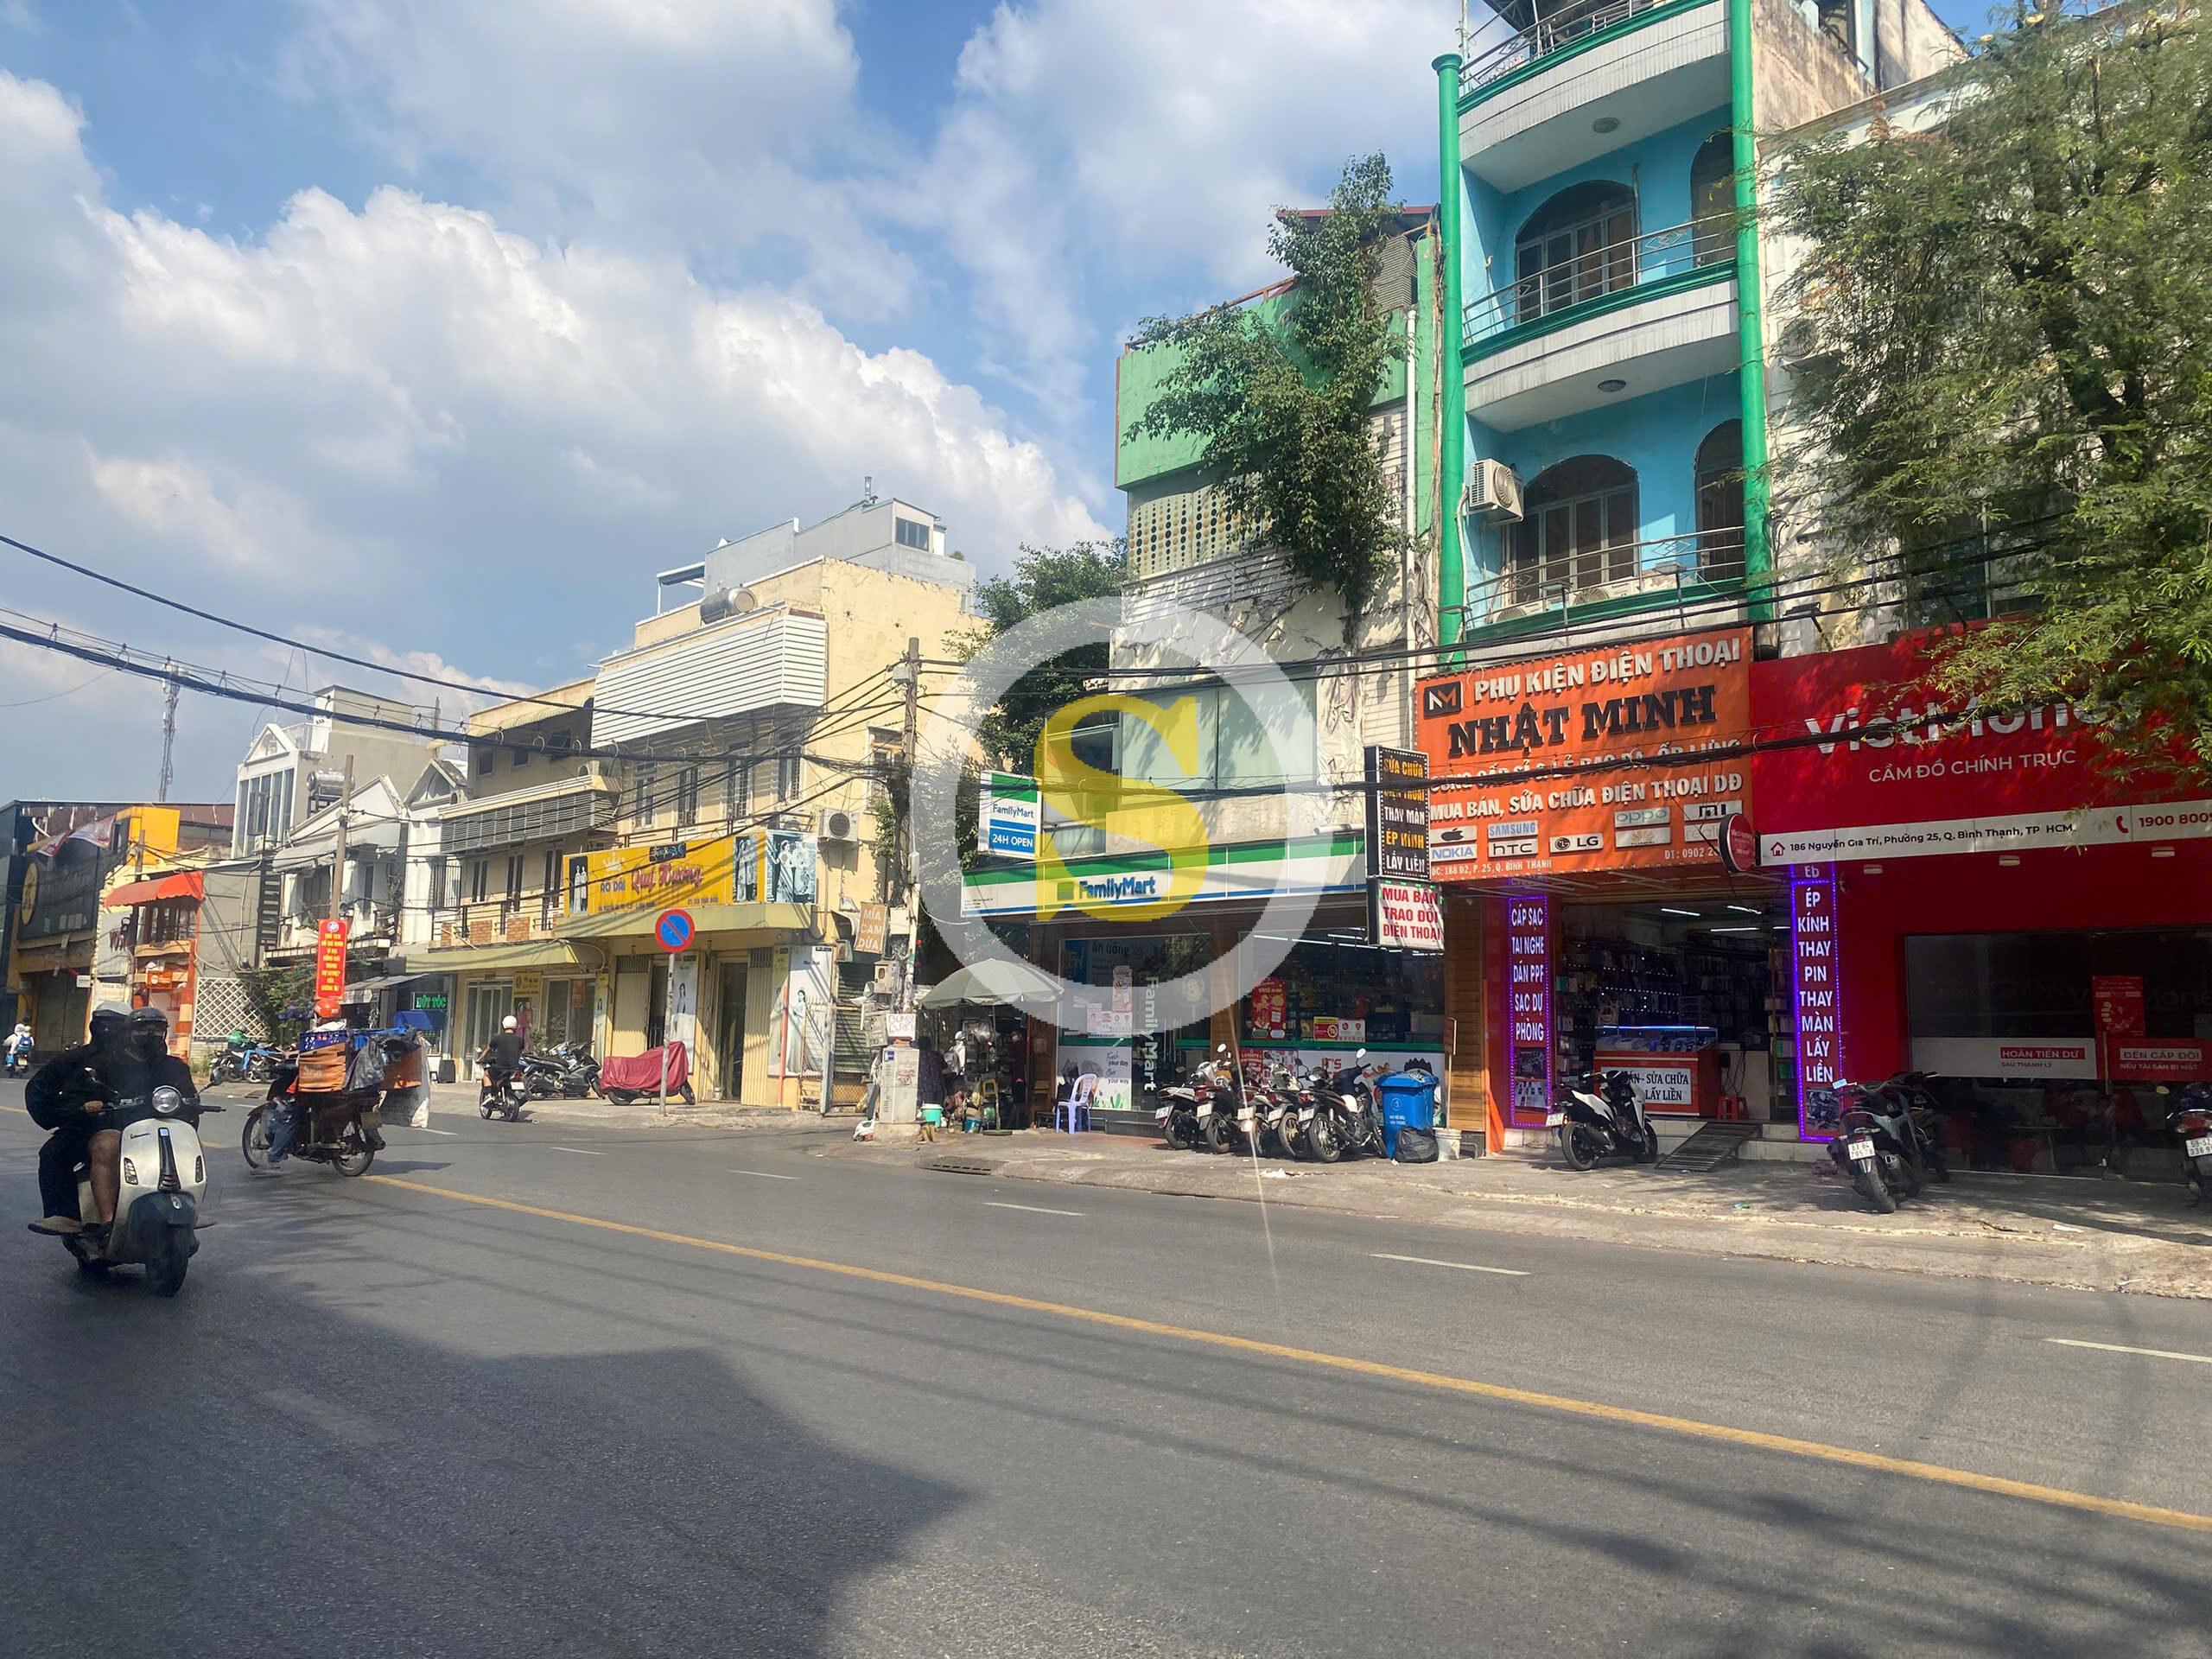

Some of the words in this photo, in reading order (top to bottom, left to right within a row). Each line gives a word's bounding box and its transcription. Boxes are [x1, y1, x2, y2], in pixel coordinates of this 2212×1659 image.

[1475, 674, 1521, 701] PHỤ
[1526, 663, 1584, 694] KIỆN
[1590, 651, 1652, 683] ĐIỆN
[1659, 638, 1740, 671] THOẠI
[1448, 702, 1571, 758] NHẬT
[1581, 685, 1717, 741] MINH
[1869, 763, 1911, 782] CẦM
[1916, 758, 1945, 778] ĐỒ
[1951, 754, 2012, 774] CHÍNH
[2019, 750, 2076, 769] TRỰC
[1430, 802, 1464, 820] MUA
[1467, 796, 1504, 817] BÁN,
[1510, 789, 1543, 813] SỬA
[1548, 785, 1596, 809] CHỮA
[1601, 780, 1645, 804] ĐIỆN
[1651, 776, 1709, 798] THOẠI
[992, 804, 1034, 818] FamilyMart
[1384, 806, 1404, 822] THAY
[1407, 807, 1425, 824] MÀN
[2139, 815, 2174, 828] 1900
[2179, 812, 2212, 824] 800
[1386, 829, 1398, 844] ÉP
[1489, 823, 1535, 836] SAMSUNG
[1790, 842, 1806, 852] 186
[1808, 838, 1846, 852] Nguyễn
[1848, 839, 1864, 848] Gia
[1866, 836, 1882, 846] Trí,
[1885, 833, 1924, 844] Phường
[1927, 832, 1942, 842] 25,
[1944, 831, 1956, 841] Q.
[1958, 829, 1982, 840] Bình
[1985, 827, 2024, 838] Thạnh,
[2026, 826, 2040, 835] TP
[2046, 823, 2073, 834] HCM
[992, 833, 1009, 845] 24H
[1011, 836, 1033, 848] OPEN
[1577, 836, 1599, 848] LG
[1387, 850, 1403, 871] LẤY
[1433, 845, 1474, 860] NOKIA
[1682, 847, 1705, 858] 0902
[1482, 863, 1495, 873] 25,
[1079, 875, 1156, 899] FamilyMart
[1382, 887, 1408, 901] MUA
[1805, 887, 1821, 907] ÉP
[1382, 906, 1414, 921] TRAO
[1512, 903, 1527, 926] CÁP
[1529, 907, 1543, 931] SẠC
[1798, 912, 1829, 932] KÍNH
[1382, 924, 1408, 939] ĐIỆN
[1410, 925, 1440, 943] THOẠI
[1512, 936, 1522, 955] TAI
[1524, 936, 1544, 955] NGHE
[1799, 940, 1831, 957] THAY
[1513, 960, 1529, 982] DÁN
[1530, 964, 1544, 982] PPF
[1804, 965, 1827, 982] PIN
[1515, 994, 1530, 1016] SẠC
[1532, 993, 1543, 1016] DỰ
[1800, 991, 1833, 1007] THAY
[1516, 1018, 1544, 1041] PHÒNG
[1802, 1011, 1834, 1032] MÀN
[1141, 976, 1159, 1091] FamilyMart
[1806, 1034, 1830, 1057] LẤY
[1646, 1071, 1663, 1084] SỬA
[1665, 1071, 1689, 1085] CHỮA
[1806, 1058, 1834, 1084] LIỀN
[1645, 1086, 1662, 1100] LẤY
[1662, 1086, 1682, 1101] LIỀN
